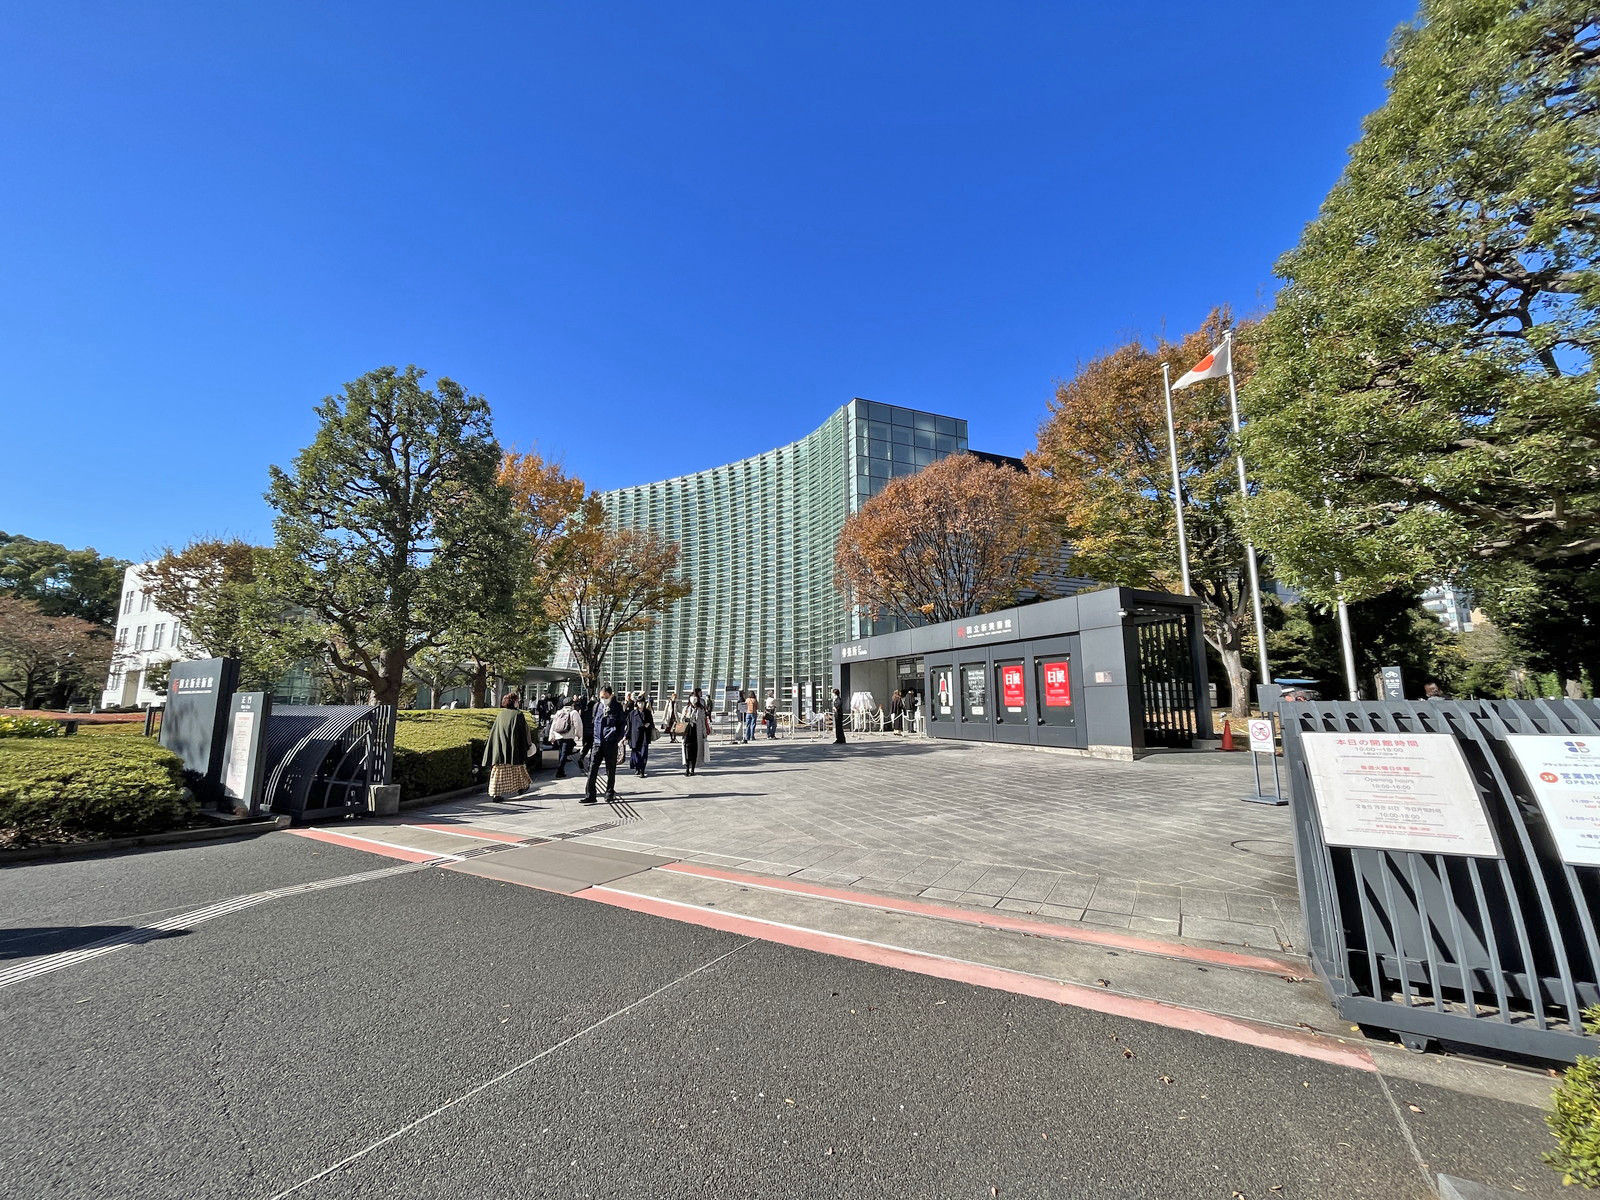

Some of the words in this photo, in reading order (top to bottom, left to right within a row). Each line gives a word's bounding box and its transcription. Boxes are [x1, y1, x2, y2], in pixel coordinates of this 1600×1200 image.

[966, 619, 1012, 635] 国立新美術館
[1005, 672, 1021, 686] 日展
[1047, 670, 1066, 684] 日展
[1336, 739, 1419, 747] 本日の開館時間
[1364, 776, 1394, 784] Opening
